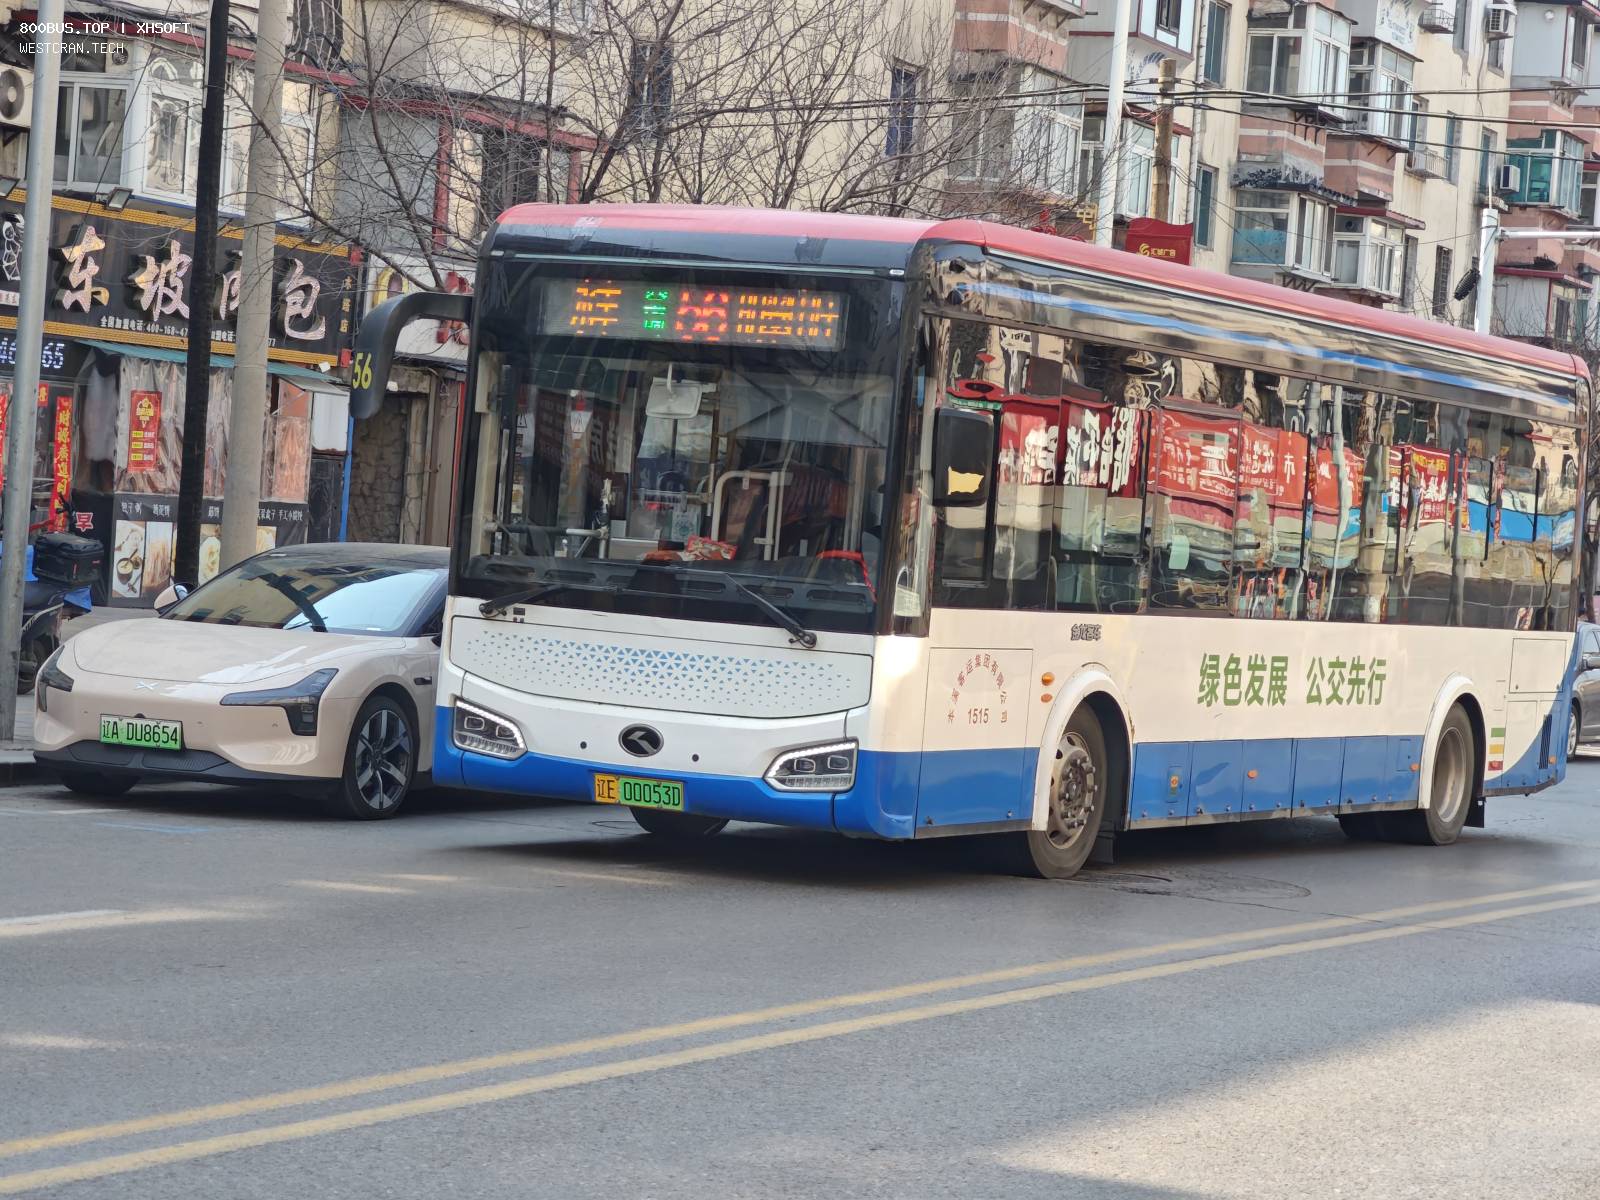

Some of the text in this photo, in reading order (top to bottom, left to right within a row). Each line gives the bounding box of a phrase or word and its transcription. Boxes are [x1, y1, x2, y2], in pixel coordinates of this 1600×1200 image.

[352, 352, 373, 390] 56
[1197, 652, 1387, 708] 绿色发展 公交先行
[967, 708, 990, 724] 1515
[103, 720, 178, 744] 辽A DU8654
[597, 778, 681, 806] 辽E 00053D
